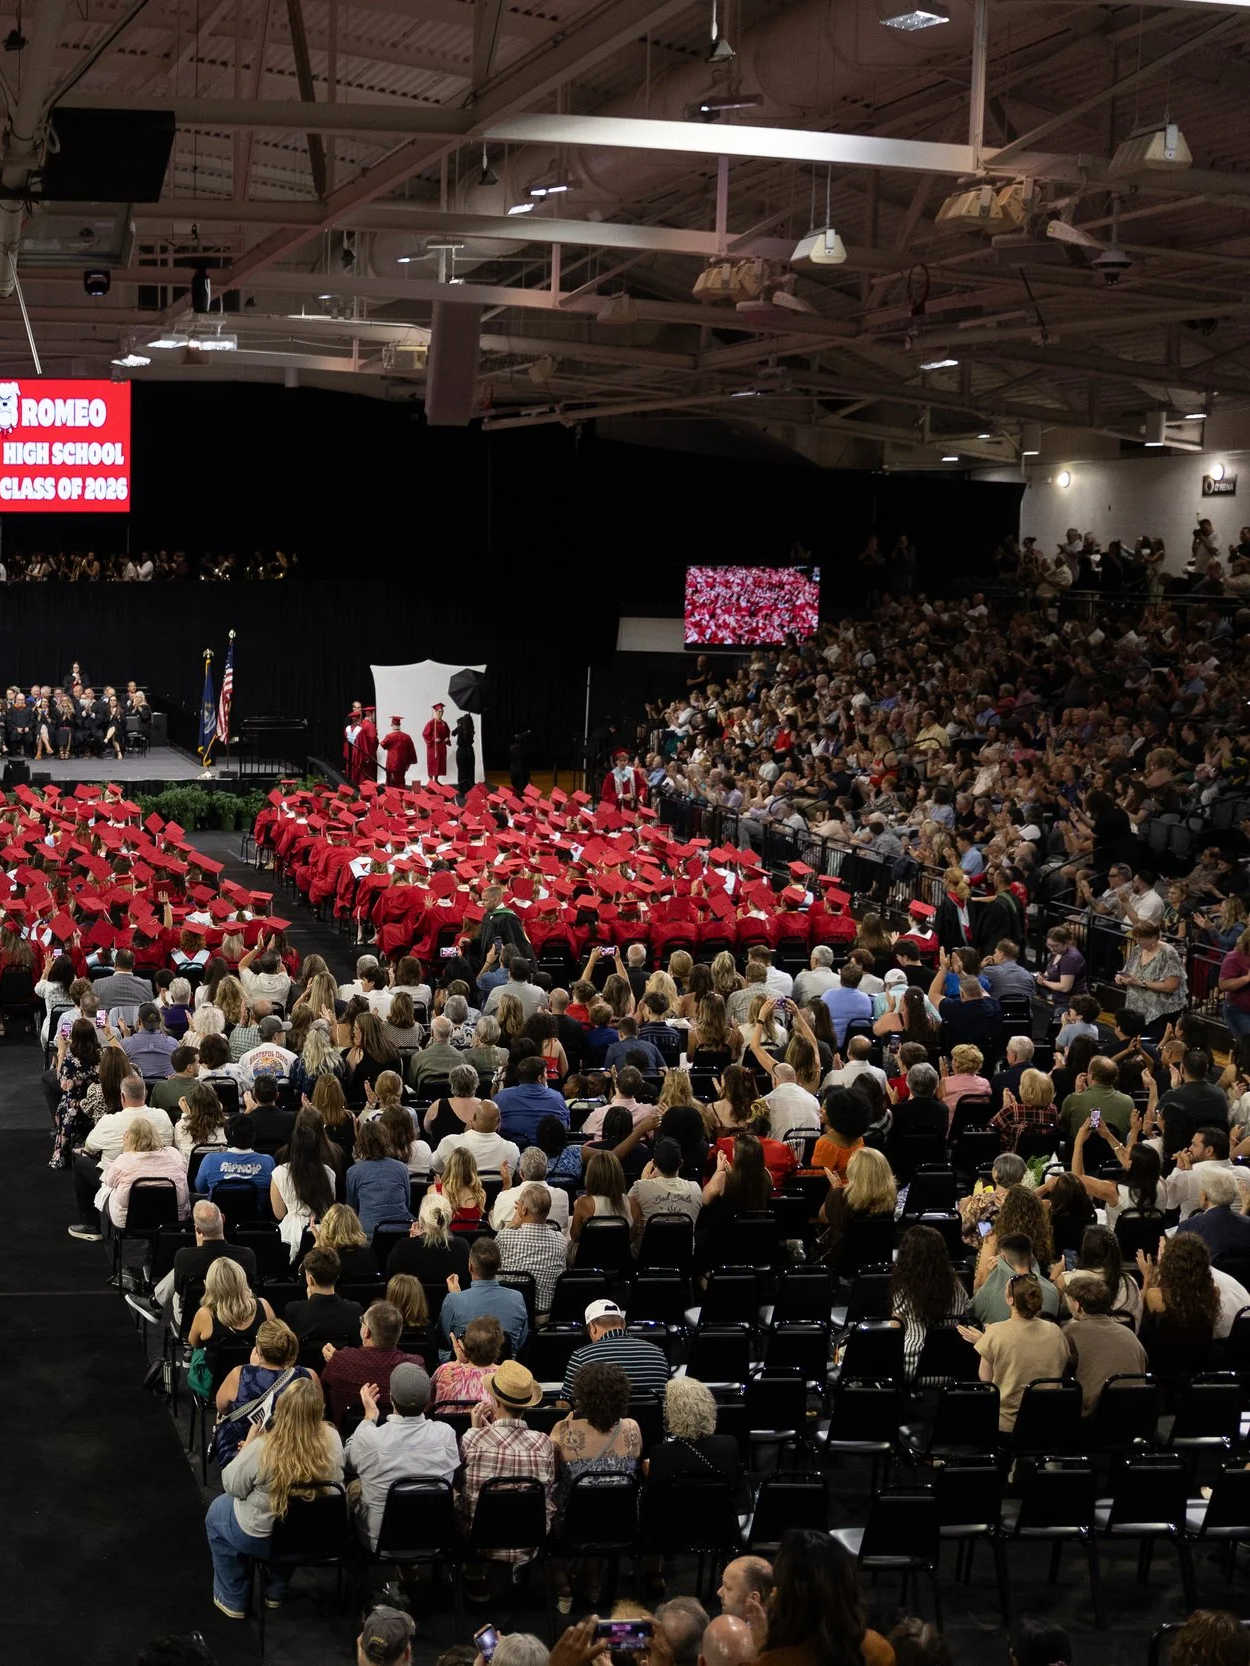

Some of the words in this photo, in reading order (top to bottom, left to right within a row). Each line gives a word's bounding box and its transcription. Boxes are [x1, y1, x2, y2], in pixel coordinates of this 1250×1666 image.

[21, 398, 107, 428] ROMEO
[2, 441, 50, 466] HIGH
[51, 441, 125, 466] SCHOOL
[57, 476, 83, 501] OF
[84, 476, 129, 501] 2026
